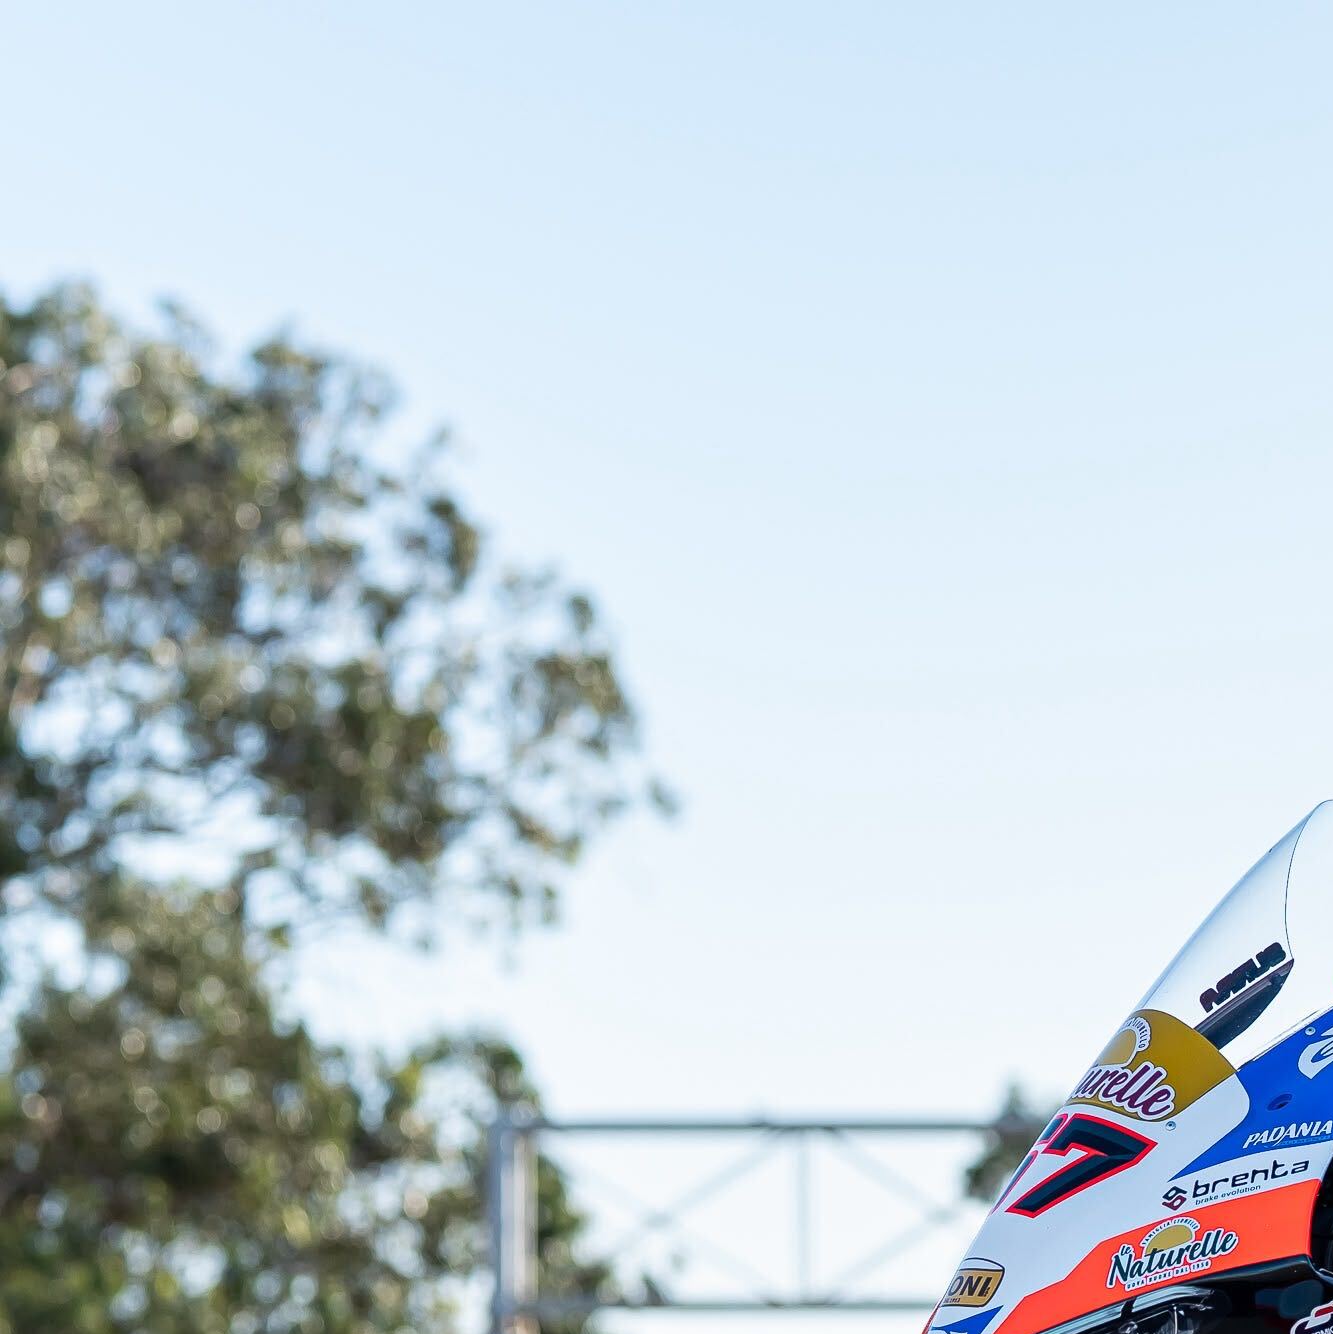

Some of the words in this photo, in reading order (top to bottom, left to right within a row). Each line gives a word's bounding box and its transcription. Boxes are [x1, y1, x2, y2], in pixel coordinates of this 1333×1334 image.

[1074, 1063, 1171, 1117] urelle
[1243, 1120, 1333, 1149] PADANIA
[1192, 1159, 1310, 1198] brenta
[1195, 1194, 1219, 1206] brake
[1221, 1184, 1261, 1198] evolution
[1108, 1229, 1237, 1286] Naturelle
[947, 1275, 993, 1297] ONI
